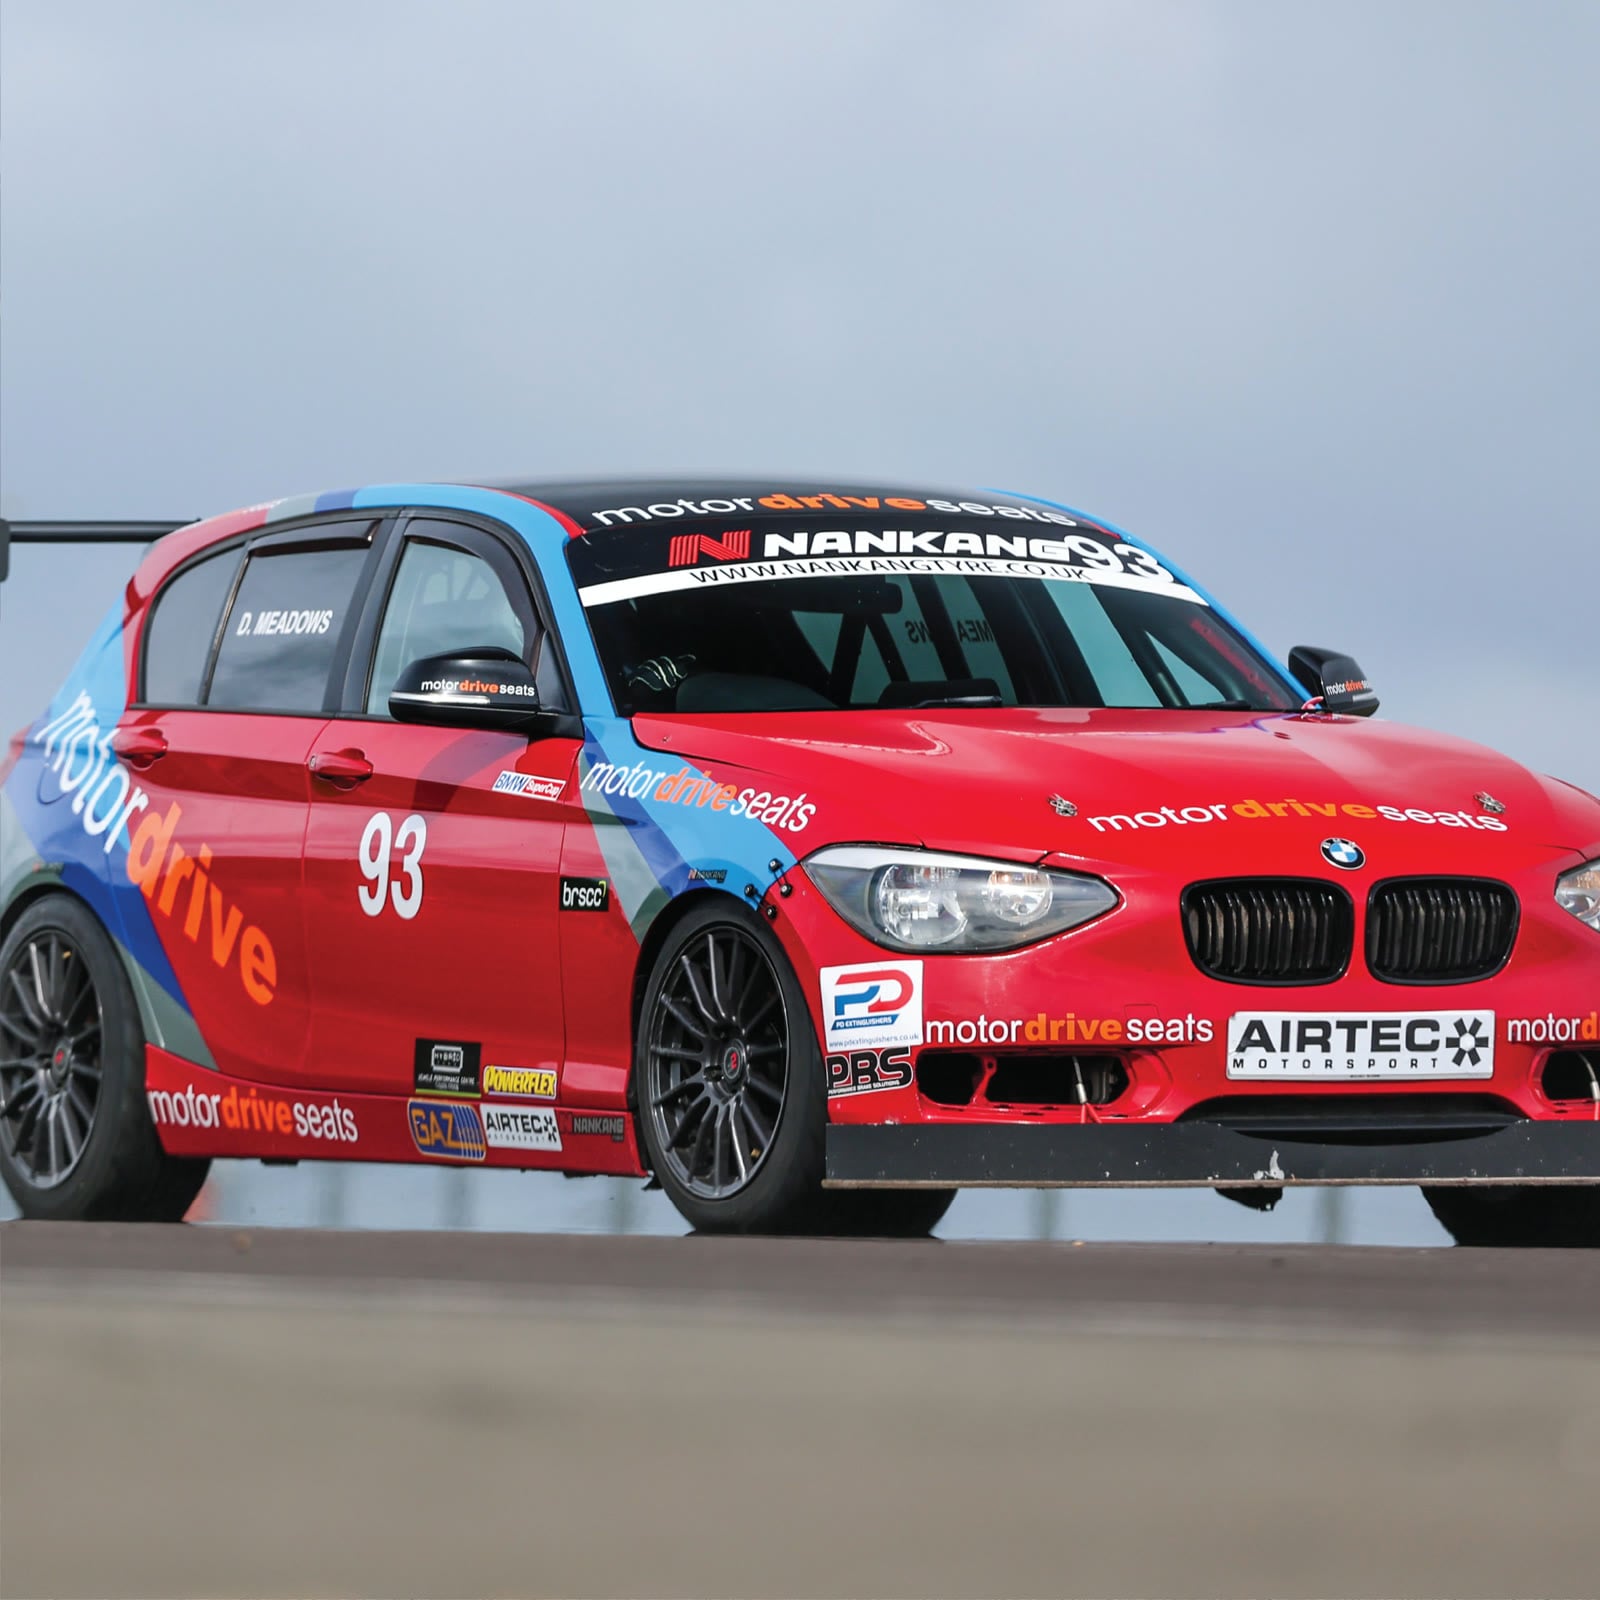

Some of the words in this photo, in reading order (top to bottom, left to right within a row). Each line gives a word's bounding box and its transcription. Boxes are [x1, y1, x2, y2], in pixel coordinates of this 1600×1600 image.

[764, 531, 1070, 563] NANKANG
[1064, 535, 1174, 583] 93
[690, 555, 1093, 584] WWW.NANKANGTYRE.CO.UK
[236, 612, 252, 636] D.
[253, 609, 333, 635] MEADOWS
[494, 773, 529, 792] BMW
[358, 811, 427, 919] 93
[563, 882, 602, 907] brscc
[1235, 1019, 1441, 1054] AIRTEC
[1232, 1058, 1438, 1070] MOTORSPORT
[484, 1065, 556, 1096] POWERFLEX
[411, 1108, 476, 1149] GAZ
[486, 1112, 541, 1134] AIRTEC
[572, 1117, 625, 1134] NANKANG
